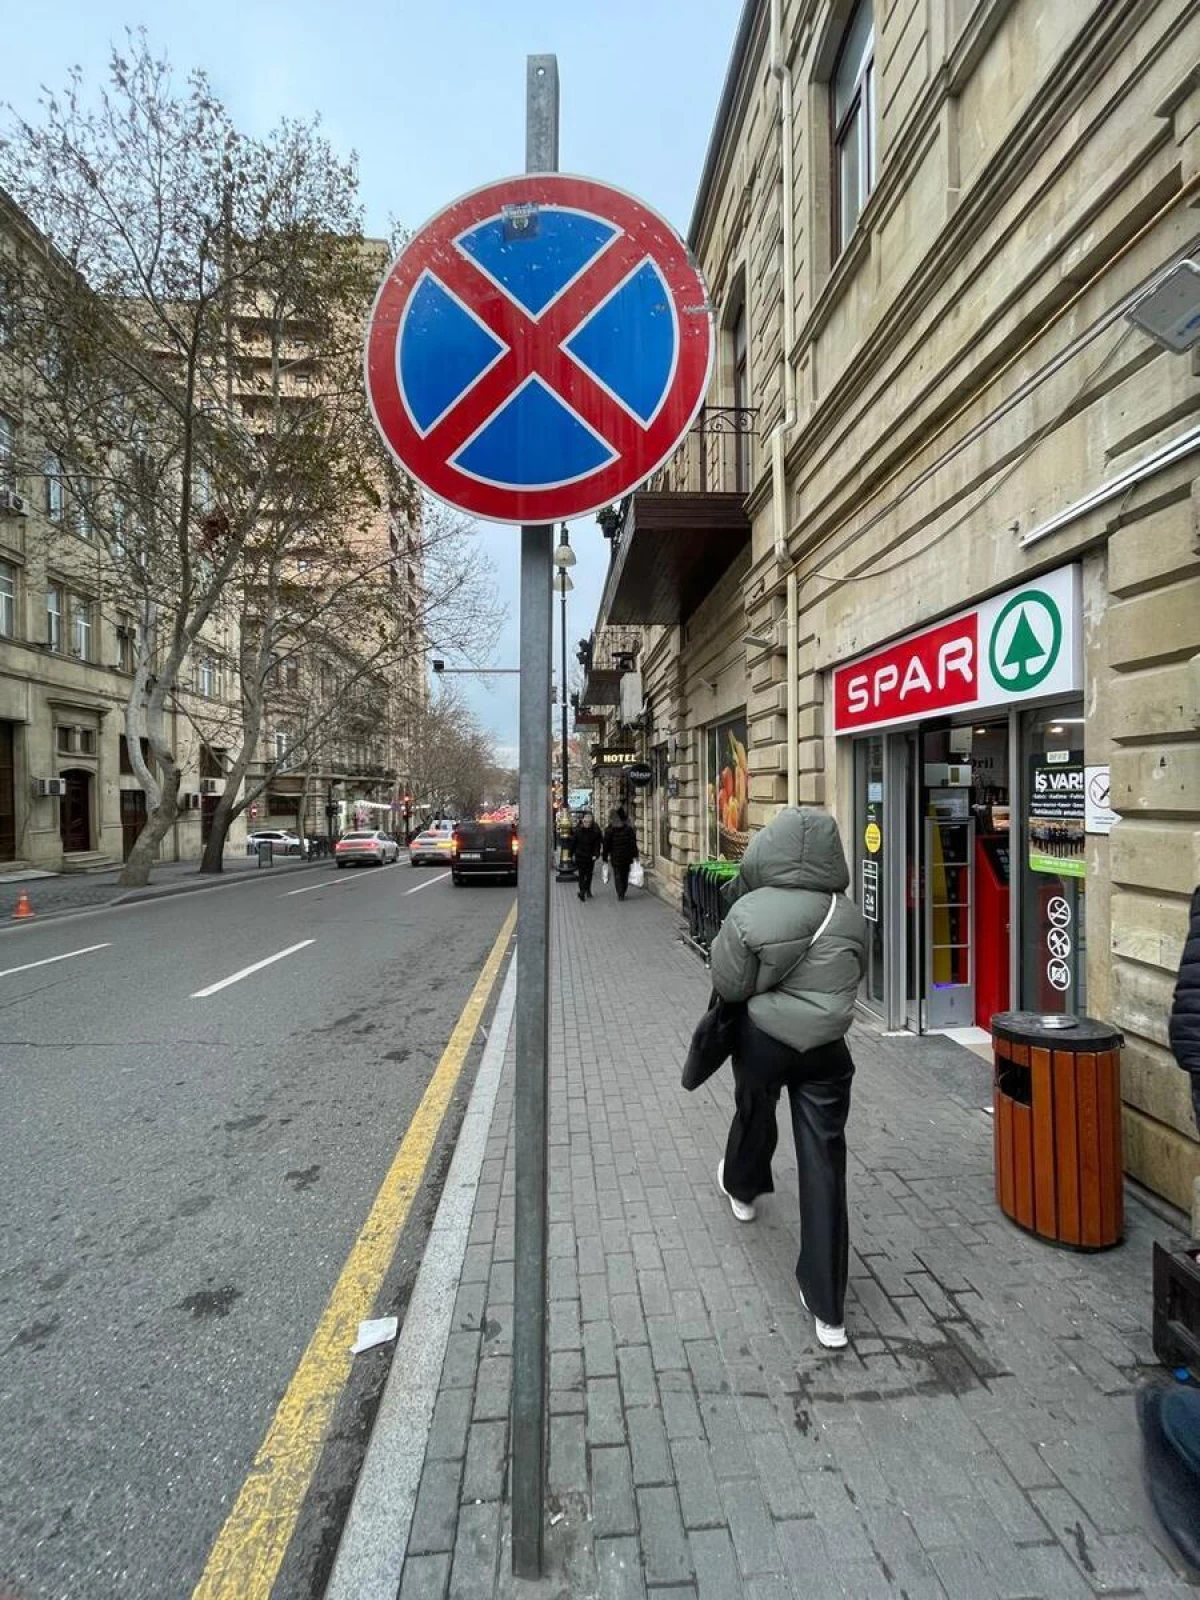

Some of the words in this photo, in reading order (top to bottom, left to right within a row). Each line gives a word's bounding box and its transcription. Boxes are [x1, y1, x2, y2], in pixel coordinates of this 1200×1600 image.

[848, 636, 973, 713] SPAR
[603, 754, 637, 763] HOTEL
[1049, 772, 1084, 790] VAR!
